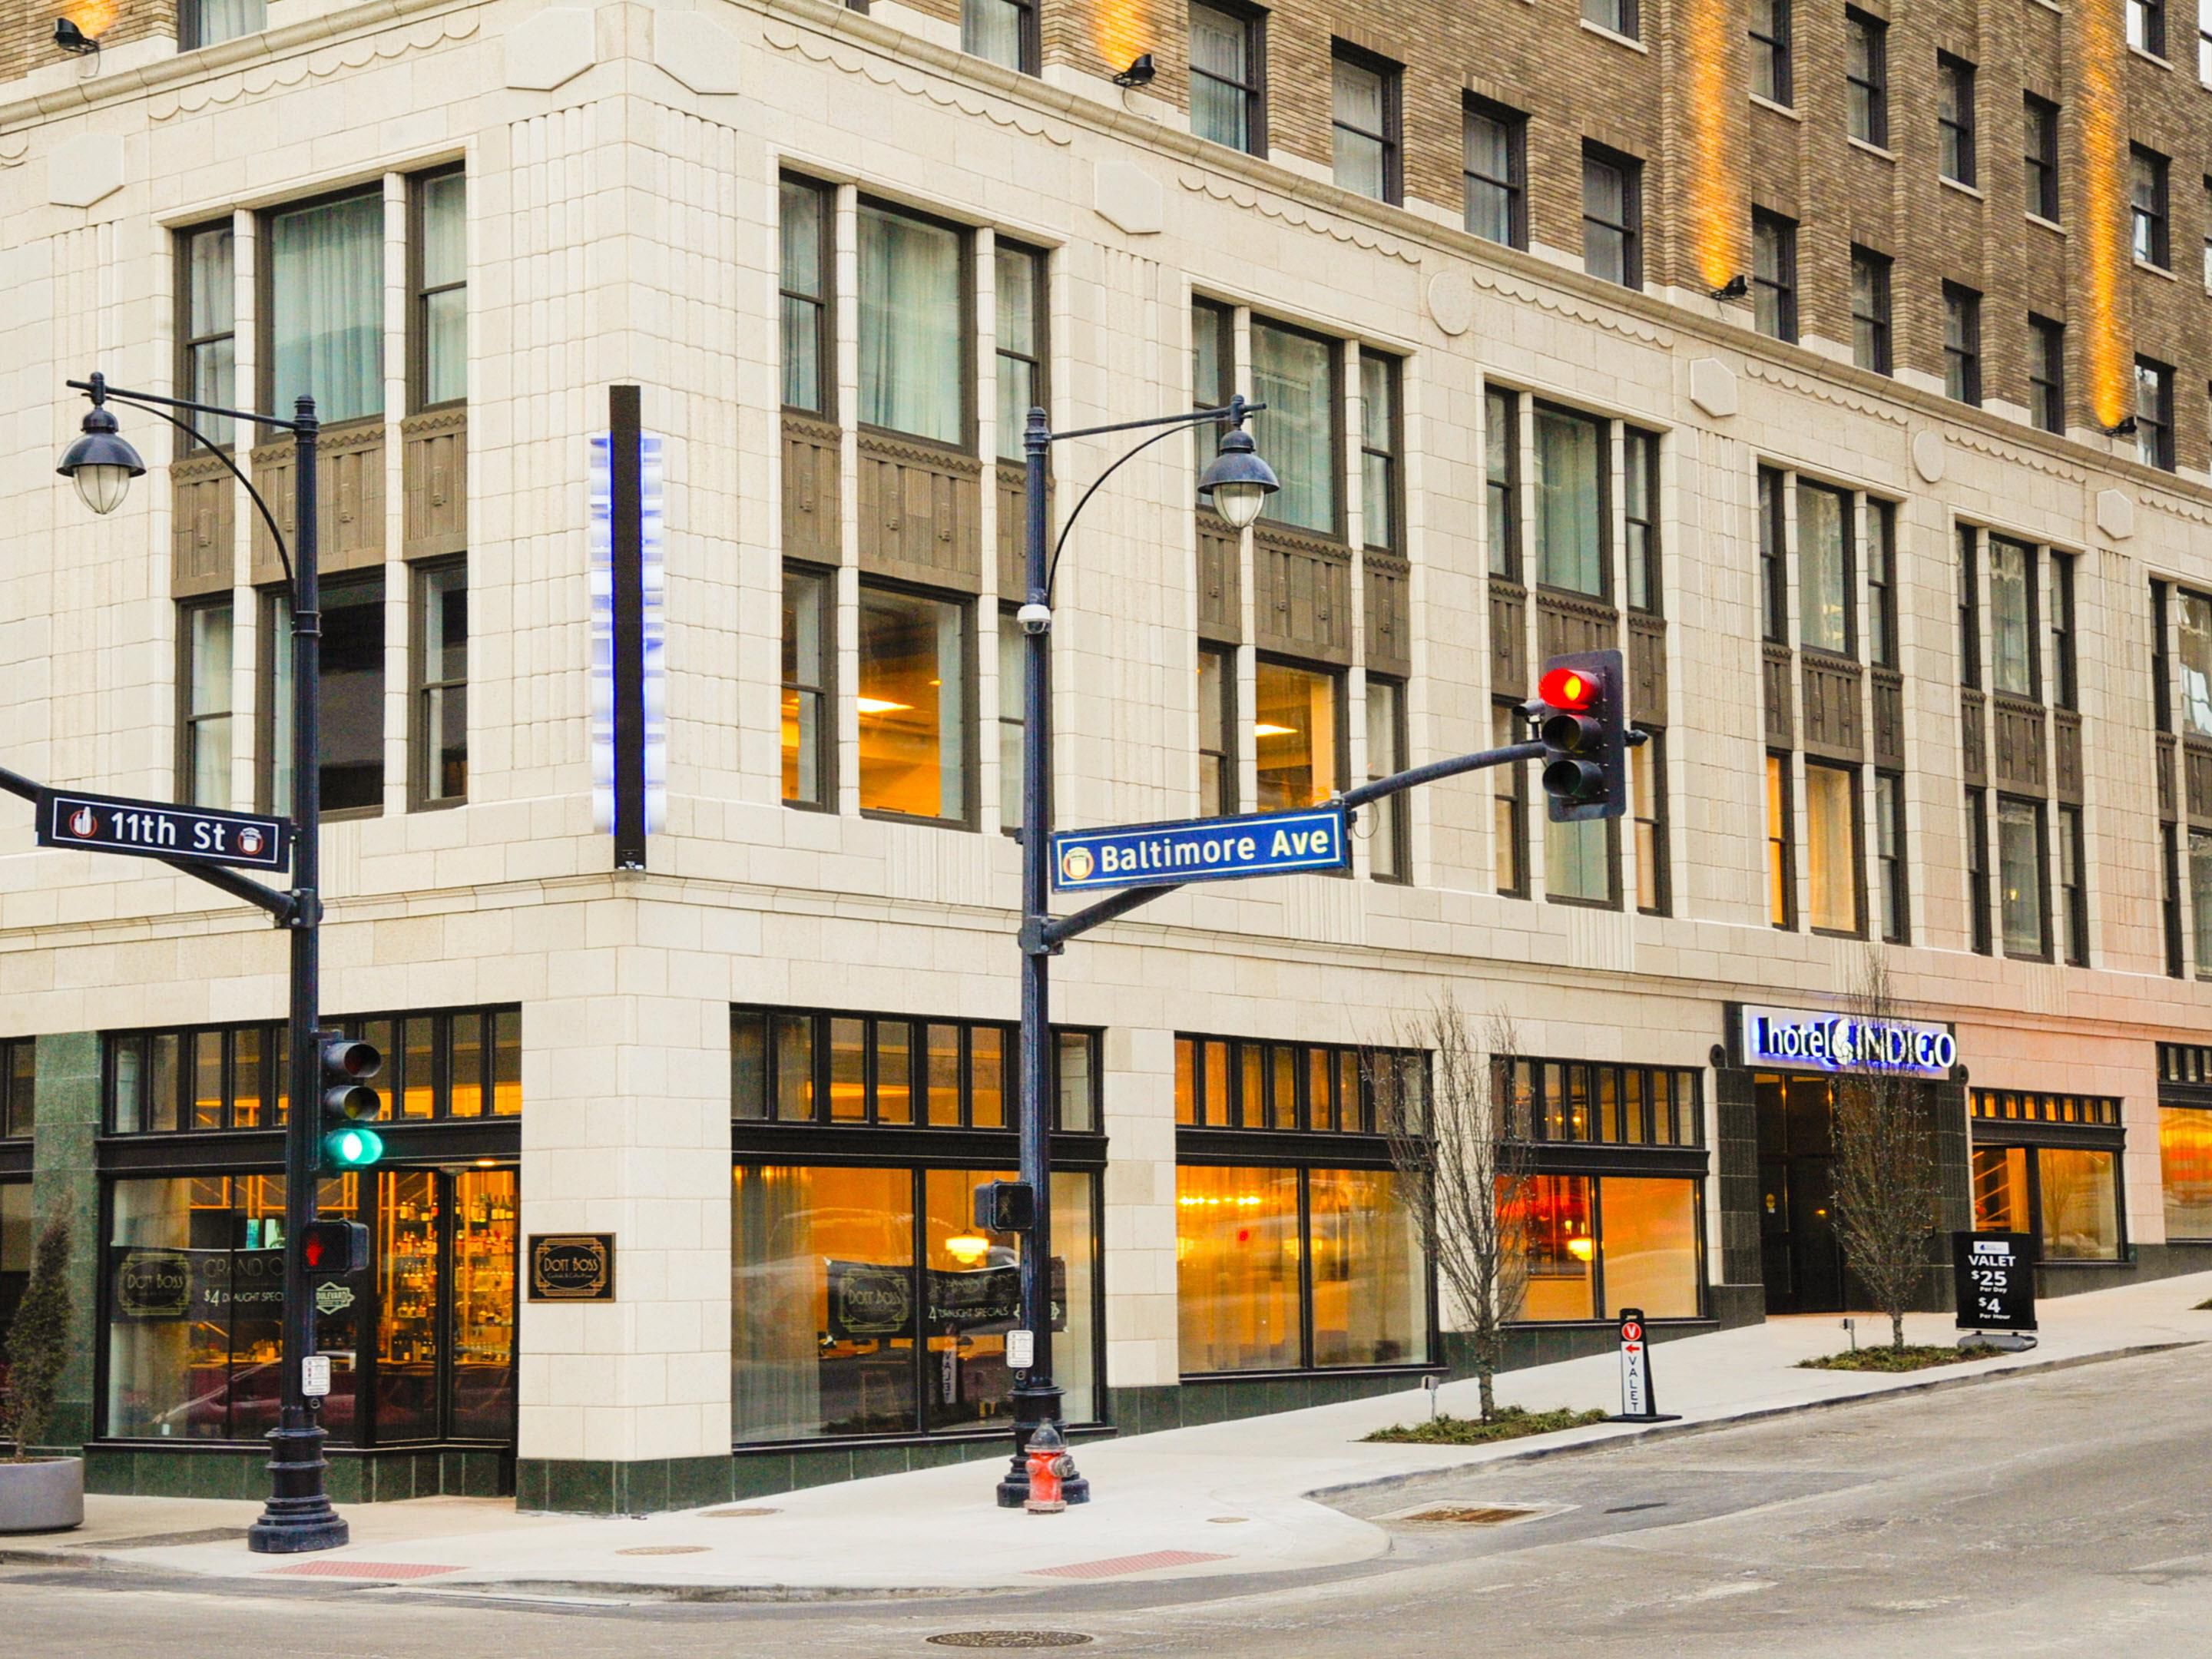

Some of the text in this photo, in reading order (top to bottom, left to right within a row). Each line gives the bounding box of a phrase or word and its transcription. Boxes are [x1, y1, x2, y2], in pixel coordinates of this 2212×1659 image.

[111, 812, 225, 851] 11th St
[1101, 830, 1329, 873] Baltimore Ave
[1768, 1017, 1957, 1068] hotel INDIGO
[572, 1257, 598, 1271] BOSS
[1968, 1255, 2016, 1267] VALET
[1971, 1270, 2007, 1286] $25
[204, 1290, 220, 1306] $4
[222, 1292, 260, 1303] DAUGHT
[1978, 1296, 2002, 1313] $4
[1626, 1325, 1637, 1338] V
[1628, 1356, 1638, 1412] VALET
